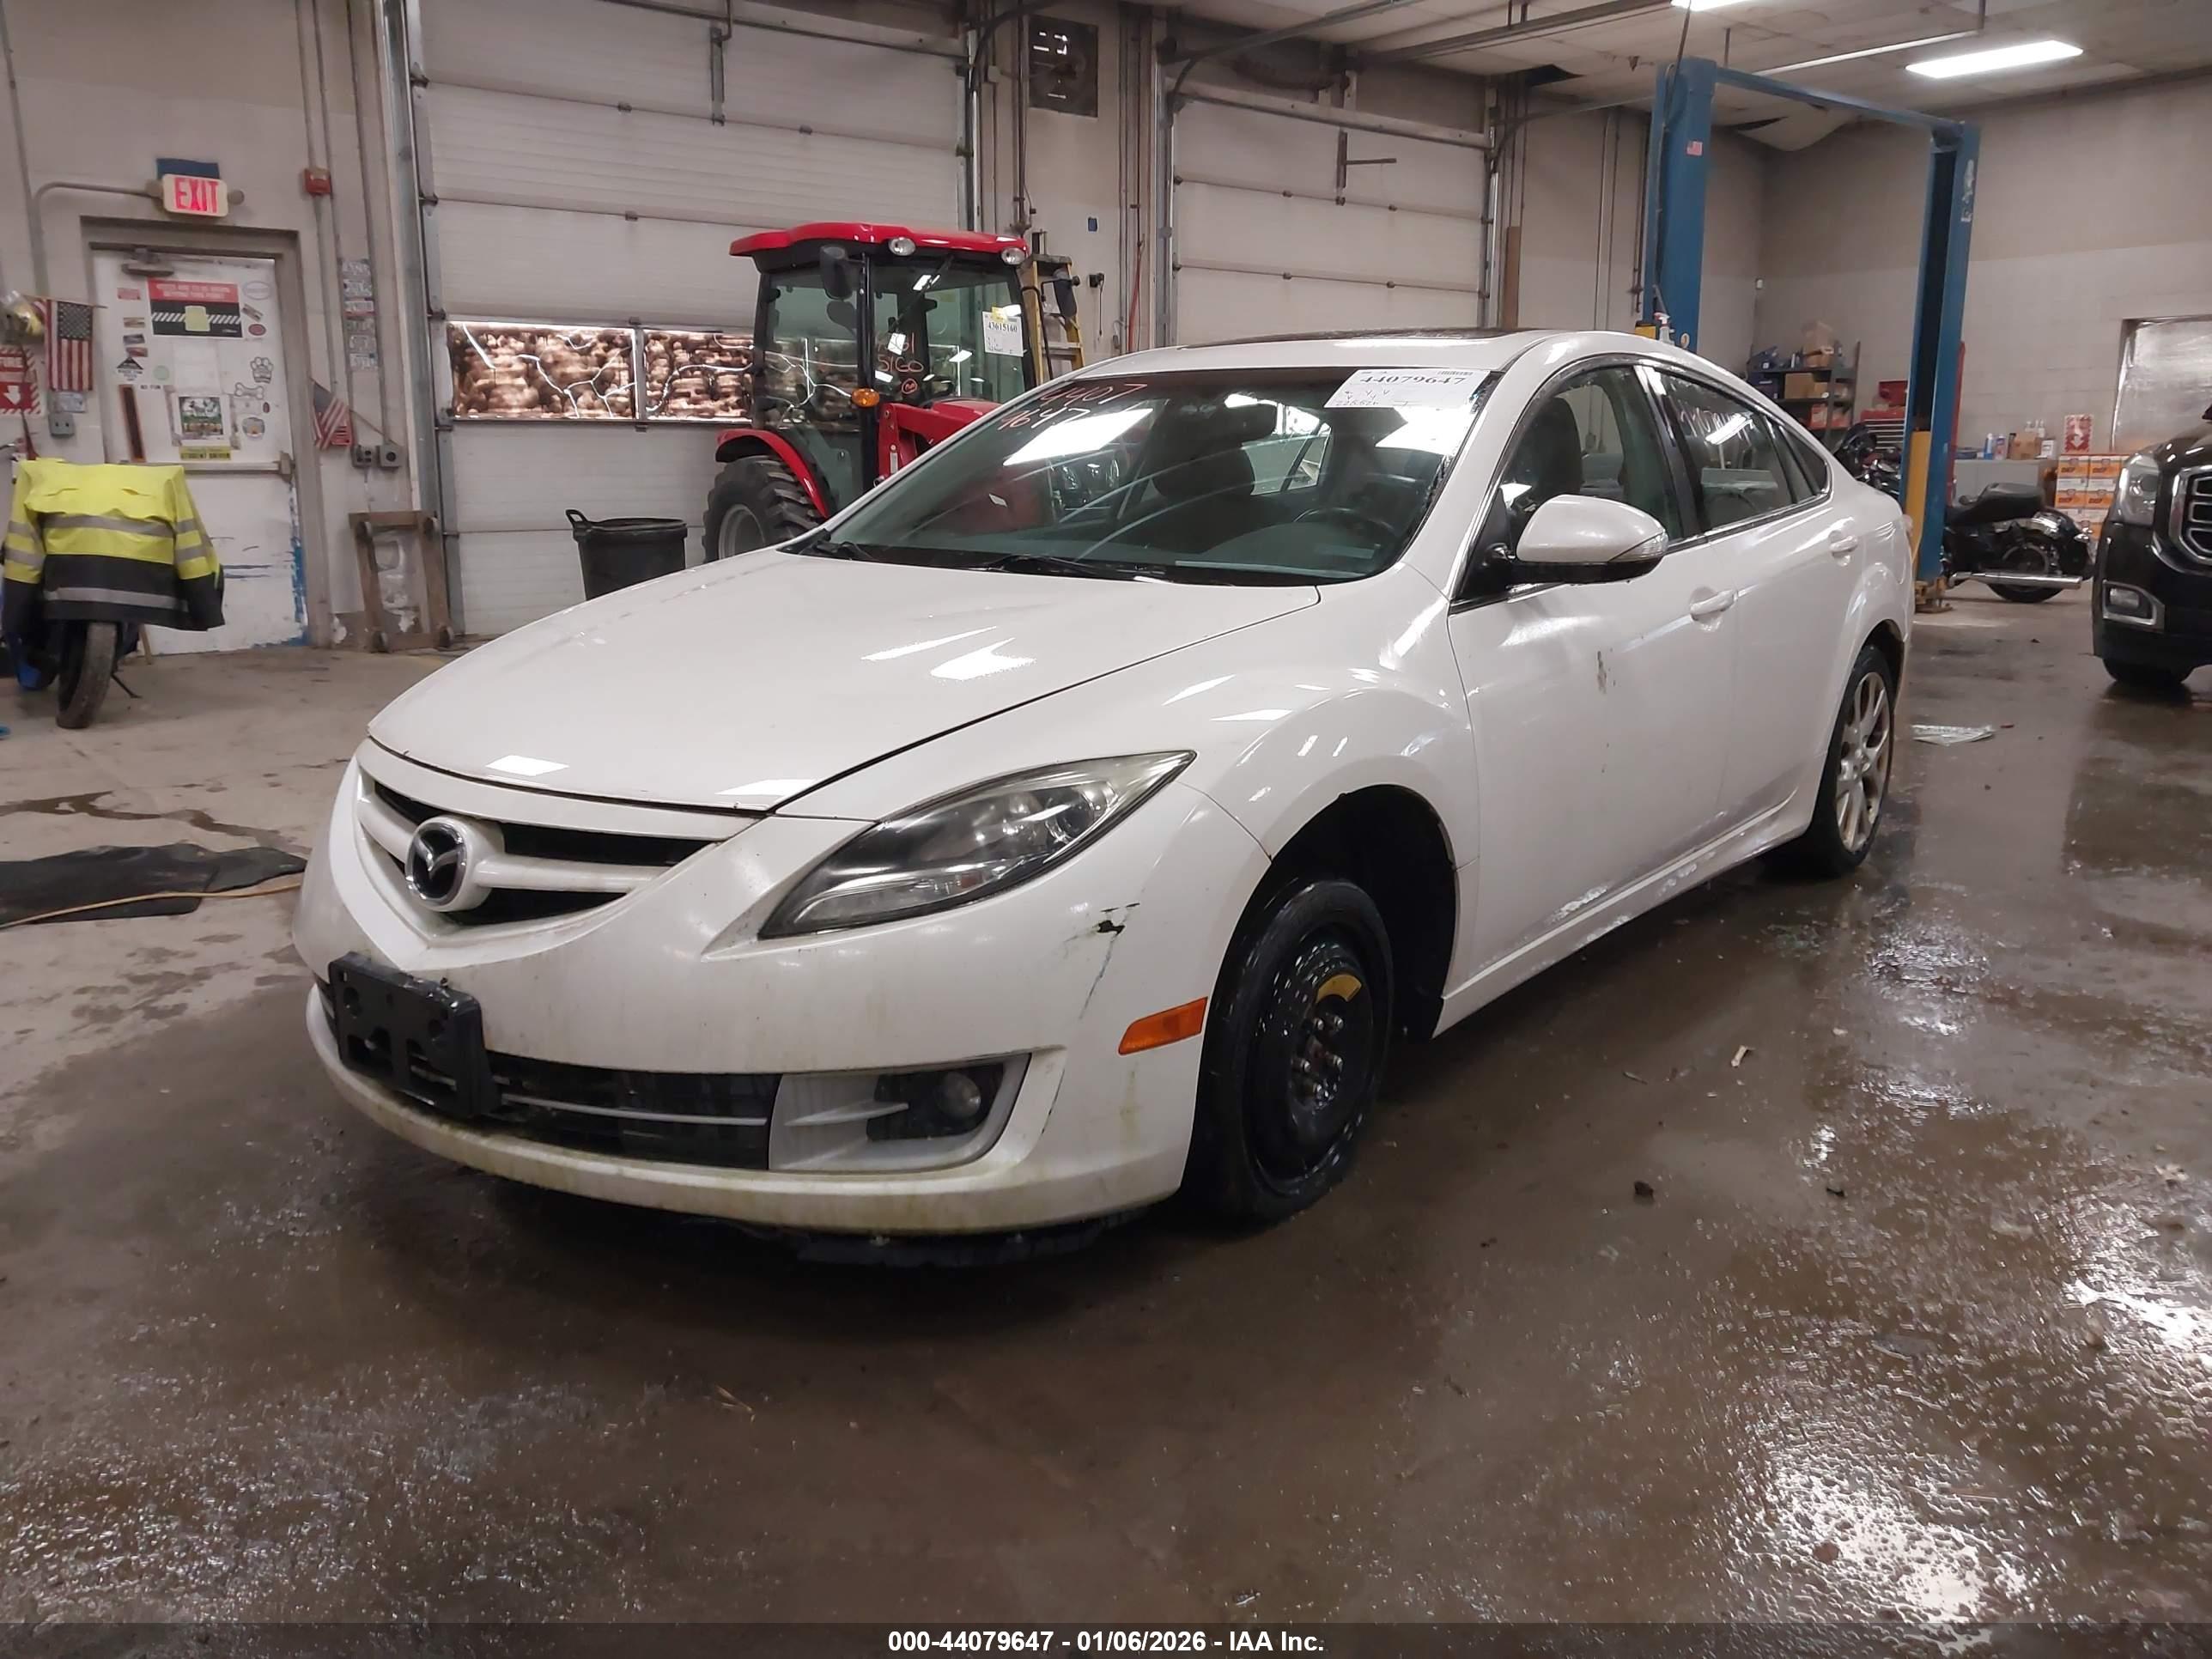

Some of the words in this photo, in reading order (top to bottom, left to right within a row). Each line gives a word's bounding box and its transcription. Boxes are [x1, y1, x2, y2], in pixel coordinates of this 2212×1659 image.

[173, 177, 219, 213] EXIT
[988, 321, 1018, 332] 43615160
[1359, 374, 1467, 385] 44079647
[1040, 383, 1147, 407] 4407
[997, 406, 1091, 430] 9647
